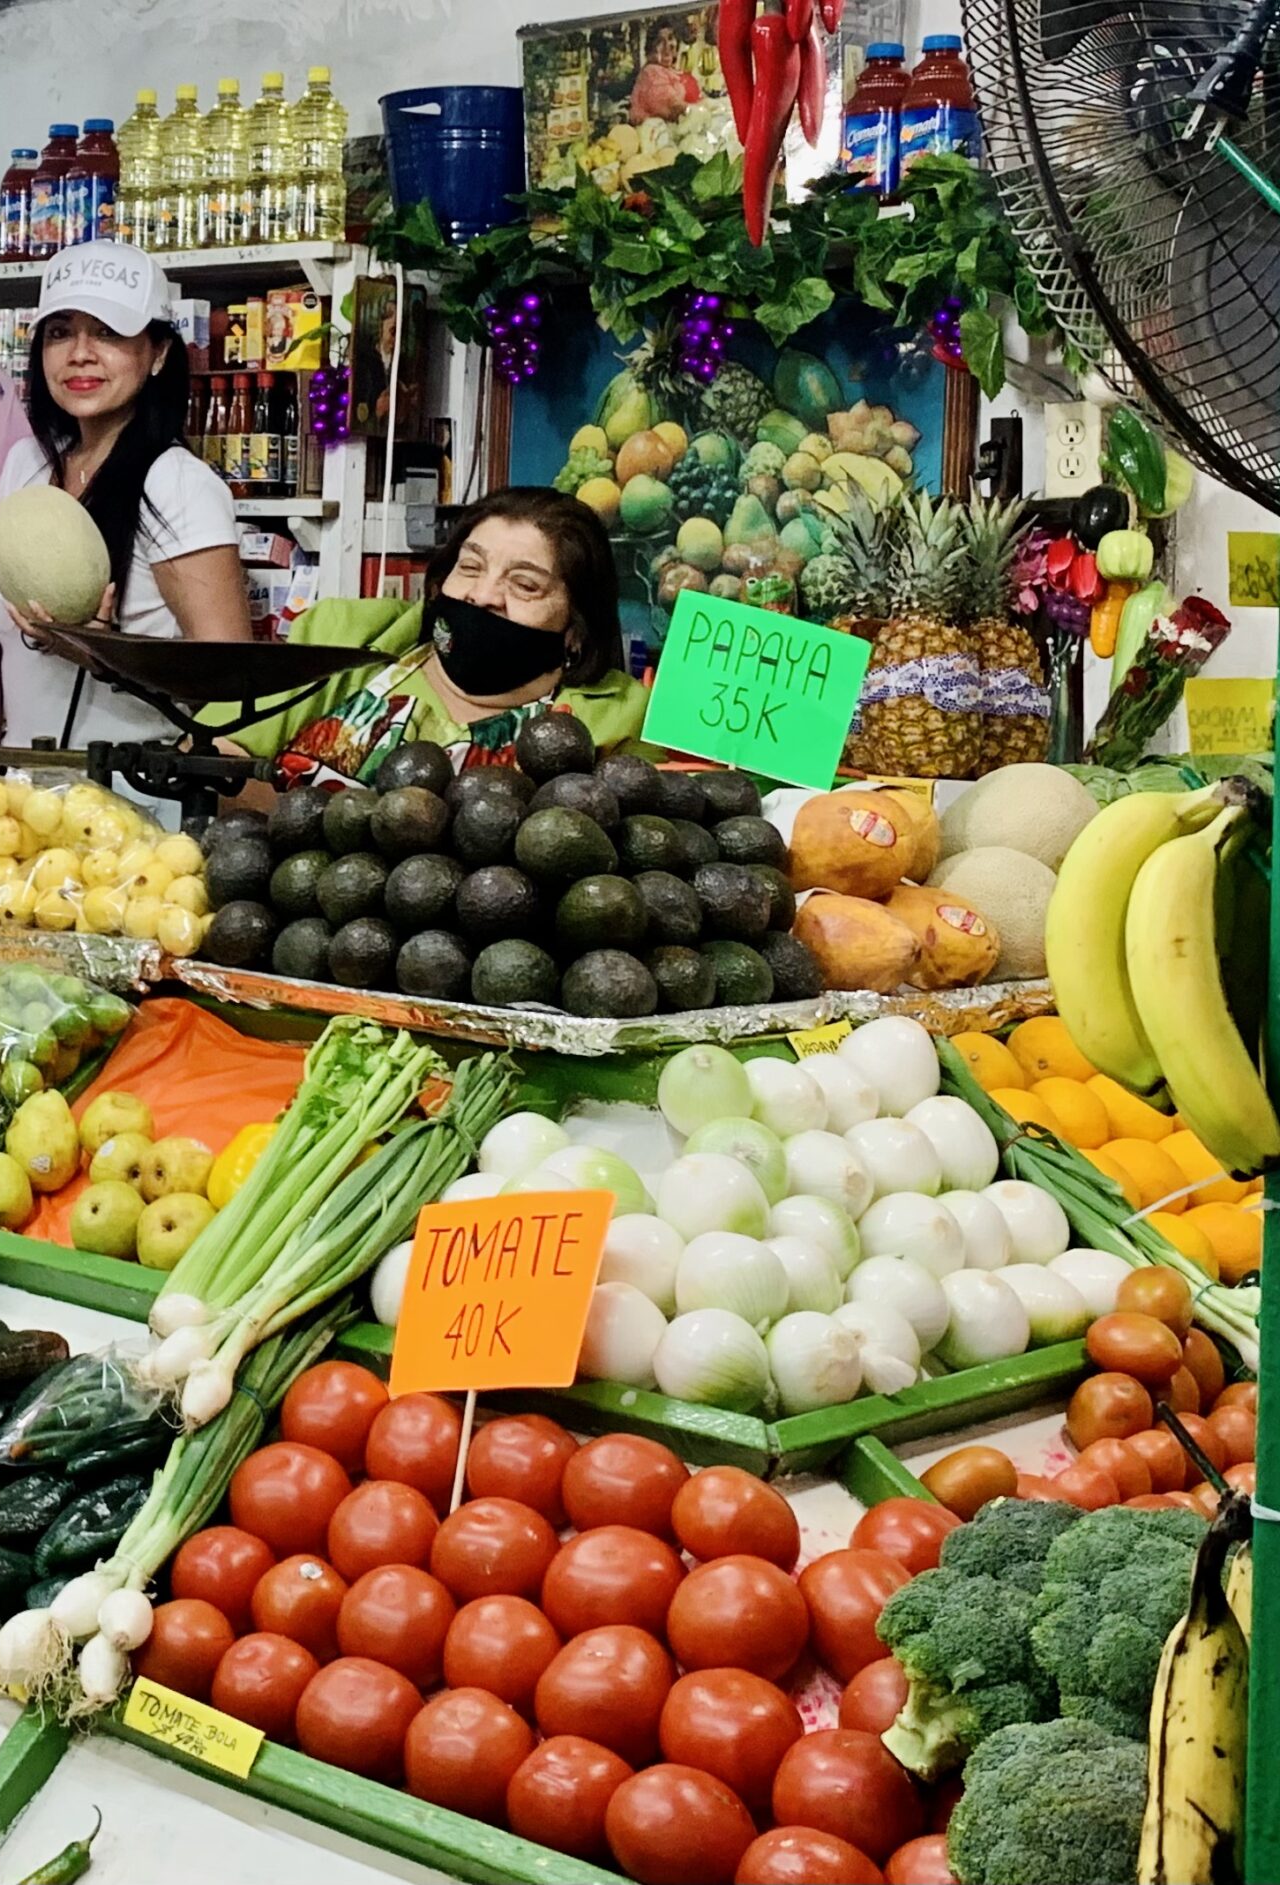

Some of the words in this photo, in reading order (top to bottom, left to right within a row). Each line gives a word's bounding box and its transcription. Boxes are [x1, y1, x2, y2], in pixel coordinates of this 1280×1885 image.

[46, 261, 73, 290] LAS
[81, 258, 140, 289] VEGAS
[683, 611, 831, 700] PAPAYA
[699, 682, 787, 743] 35K
[422, 1213, 583, 1291] TOMATE
[444, 1300, 522, 1360] 40K
[139, 1690, 202, 1733] TOMATE
[203, 1725, 238, 1751] BOLA
